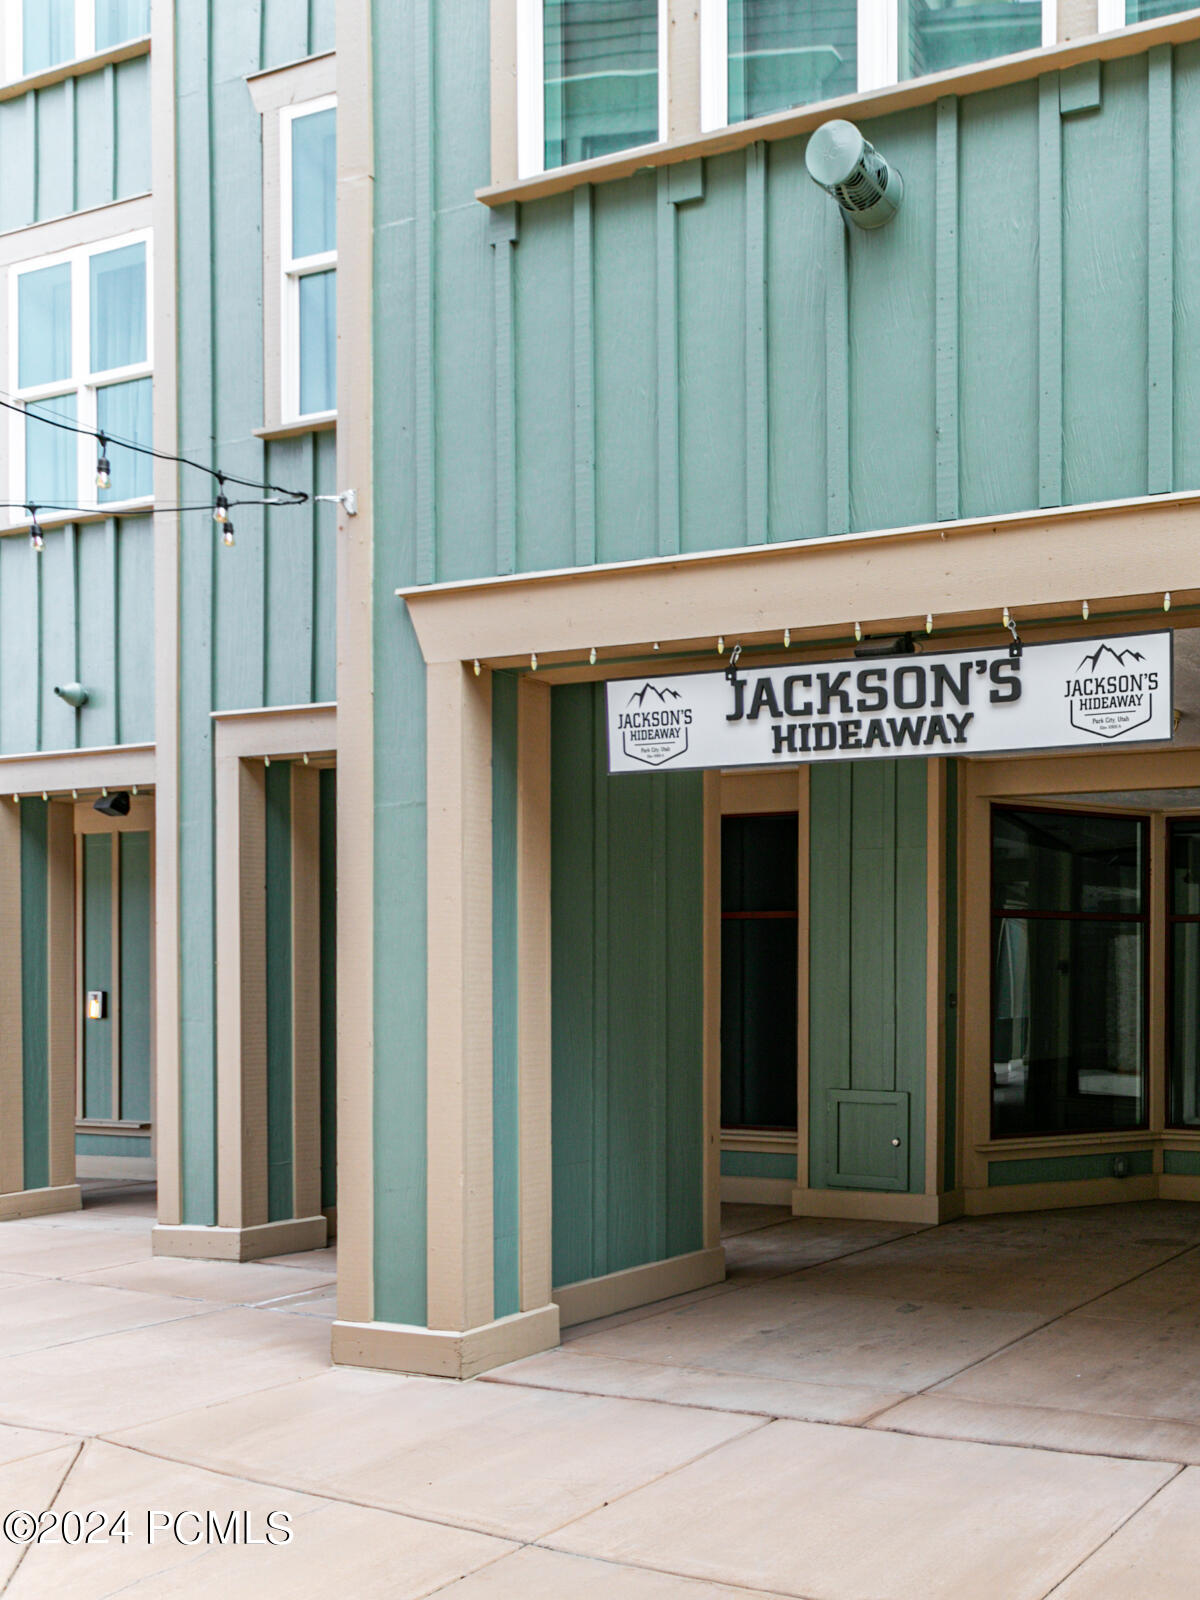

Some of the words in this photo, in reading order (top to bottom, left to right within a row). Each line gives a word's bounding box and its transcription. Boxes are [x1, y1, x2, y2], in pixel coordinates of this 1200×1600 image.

[726, 658, 1022, 721] JACKSON'S
[1064, 672, 1159, 698] JACKSON'S
[1080, 694, 1144, 711] HIDEAWAY
[618, 708, 693, 730] JACKSON'S
[630, 727, 681, 742] HIDEAWAY
[771, 712, 975, 754] HIDEAWAY
